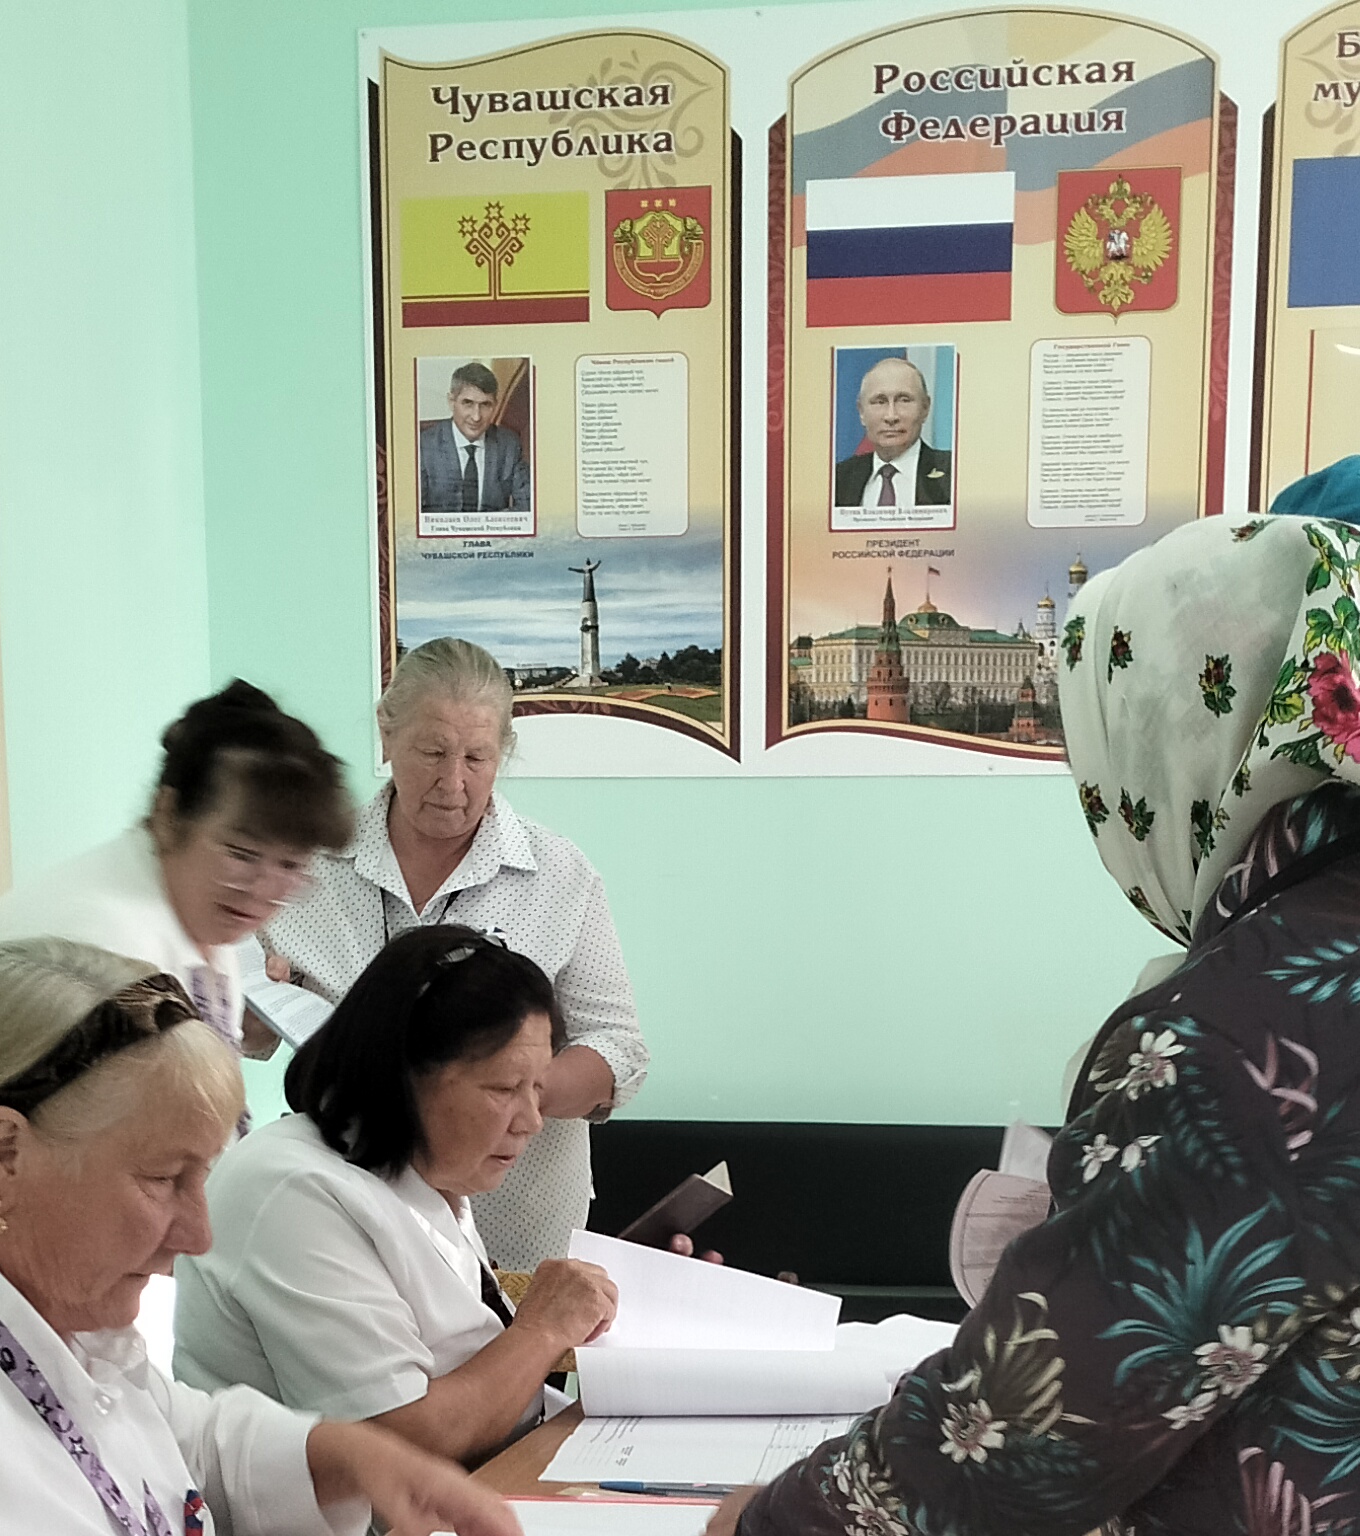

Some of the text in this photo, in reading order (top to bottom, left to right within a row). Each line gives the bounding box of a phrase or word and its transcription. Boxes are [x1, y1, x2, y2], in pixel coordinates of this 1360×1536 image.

[873, 59, 1136, 94] Российская
[431, 83, 671, 122] Чувашская
[880, 108, 1126, 145] Федерация
[428, 130, 674, 166] Республика
[421, 551, 534, 560] ЧУВАШСКОЙ РЕСПУБЛИКИ
[832, 549, 954, 559] РОССИЙСКОЙ ФЕДЕРАЦИИ
[866, 539, 920, 548] ПРЕЗИДЕНТ
